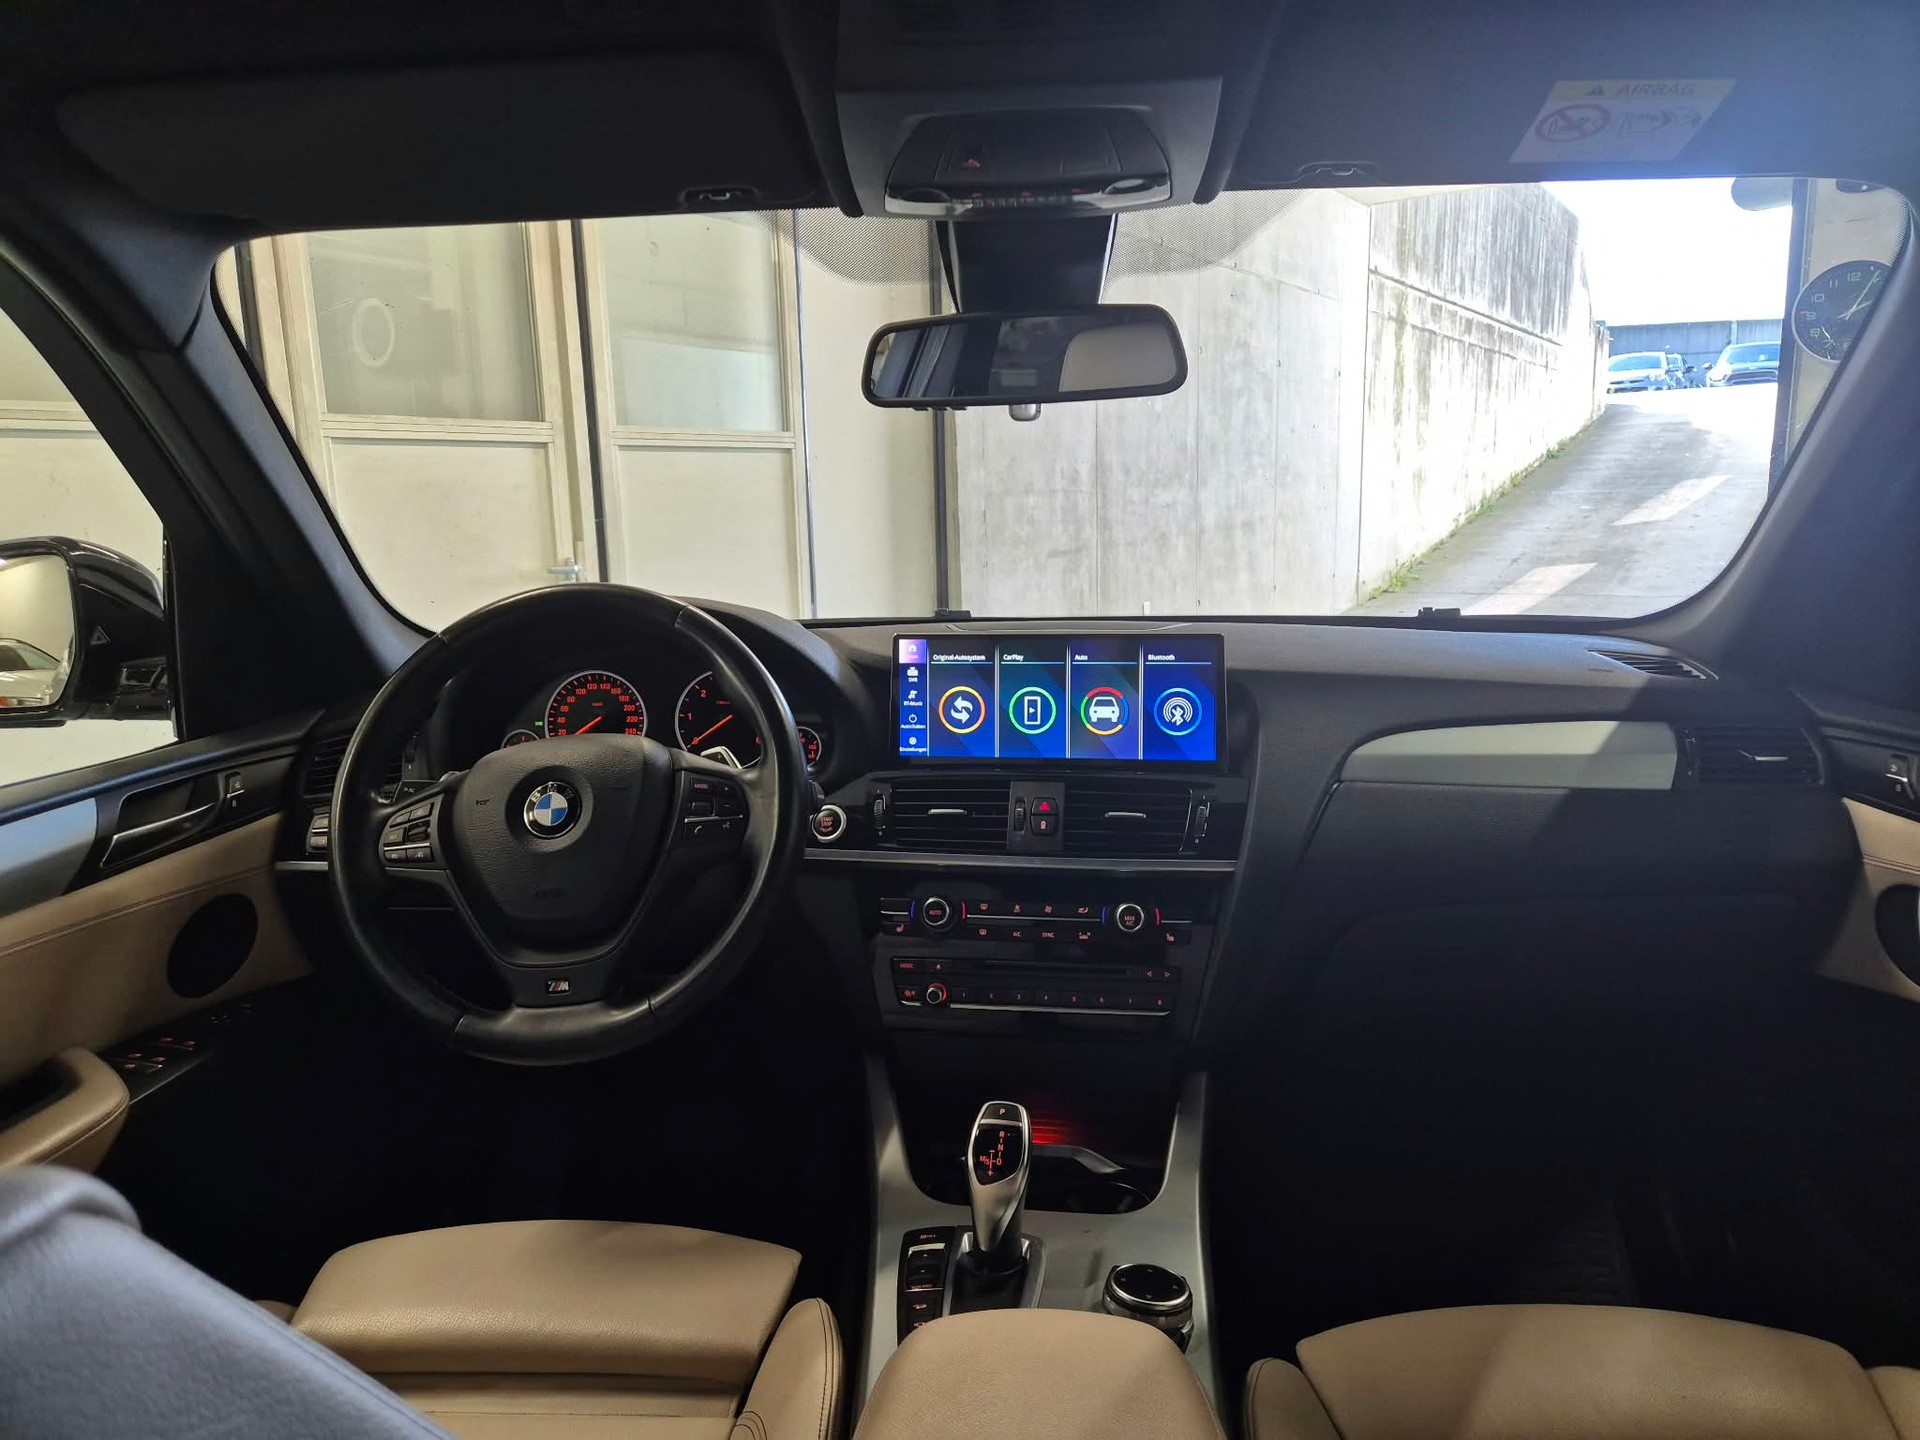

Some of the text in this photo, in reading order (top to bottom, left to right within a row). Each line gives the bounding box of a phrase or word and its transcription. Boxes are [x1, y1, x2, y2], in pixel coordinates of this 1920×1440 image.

[1847, 272, 1861, 282] 12
[1829, 279, 1838, 289] 11
[1811, 293, 1825, 303] 10
[1003, 654, 1024, 662] CarPlay
[700, 689, 708, 698] 2
